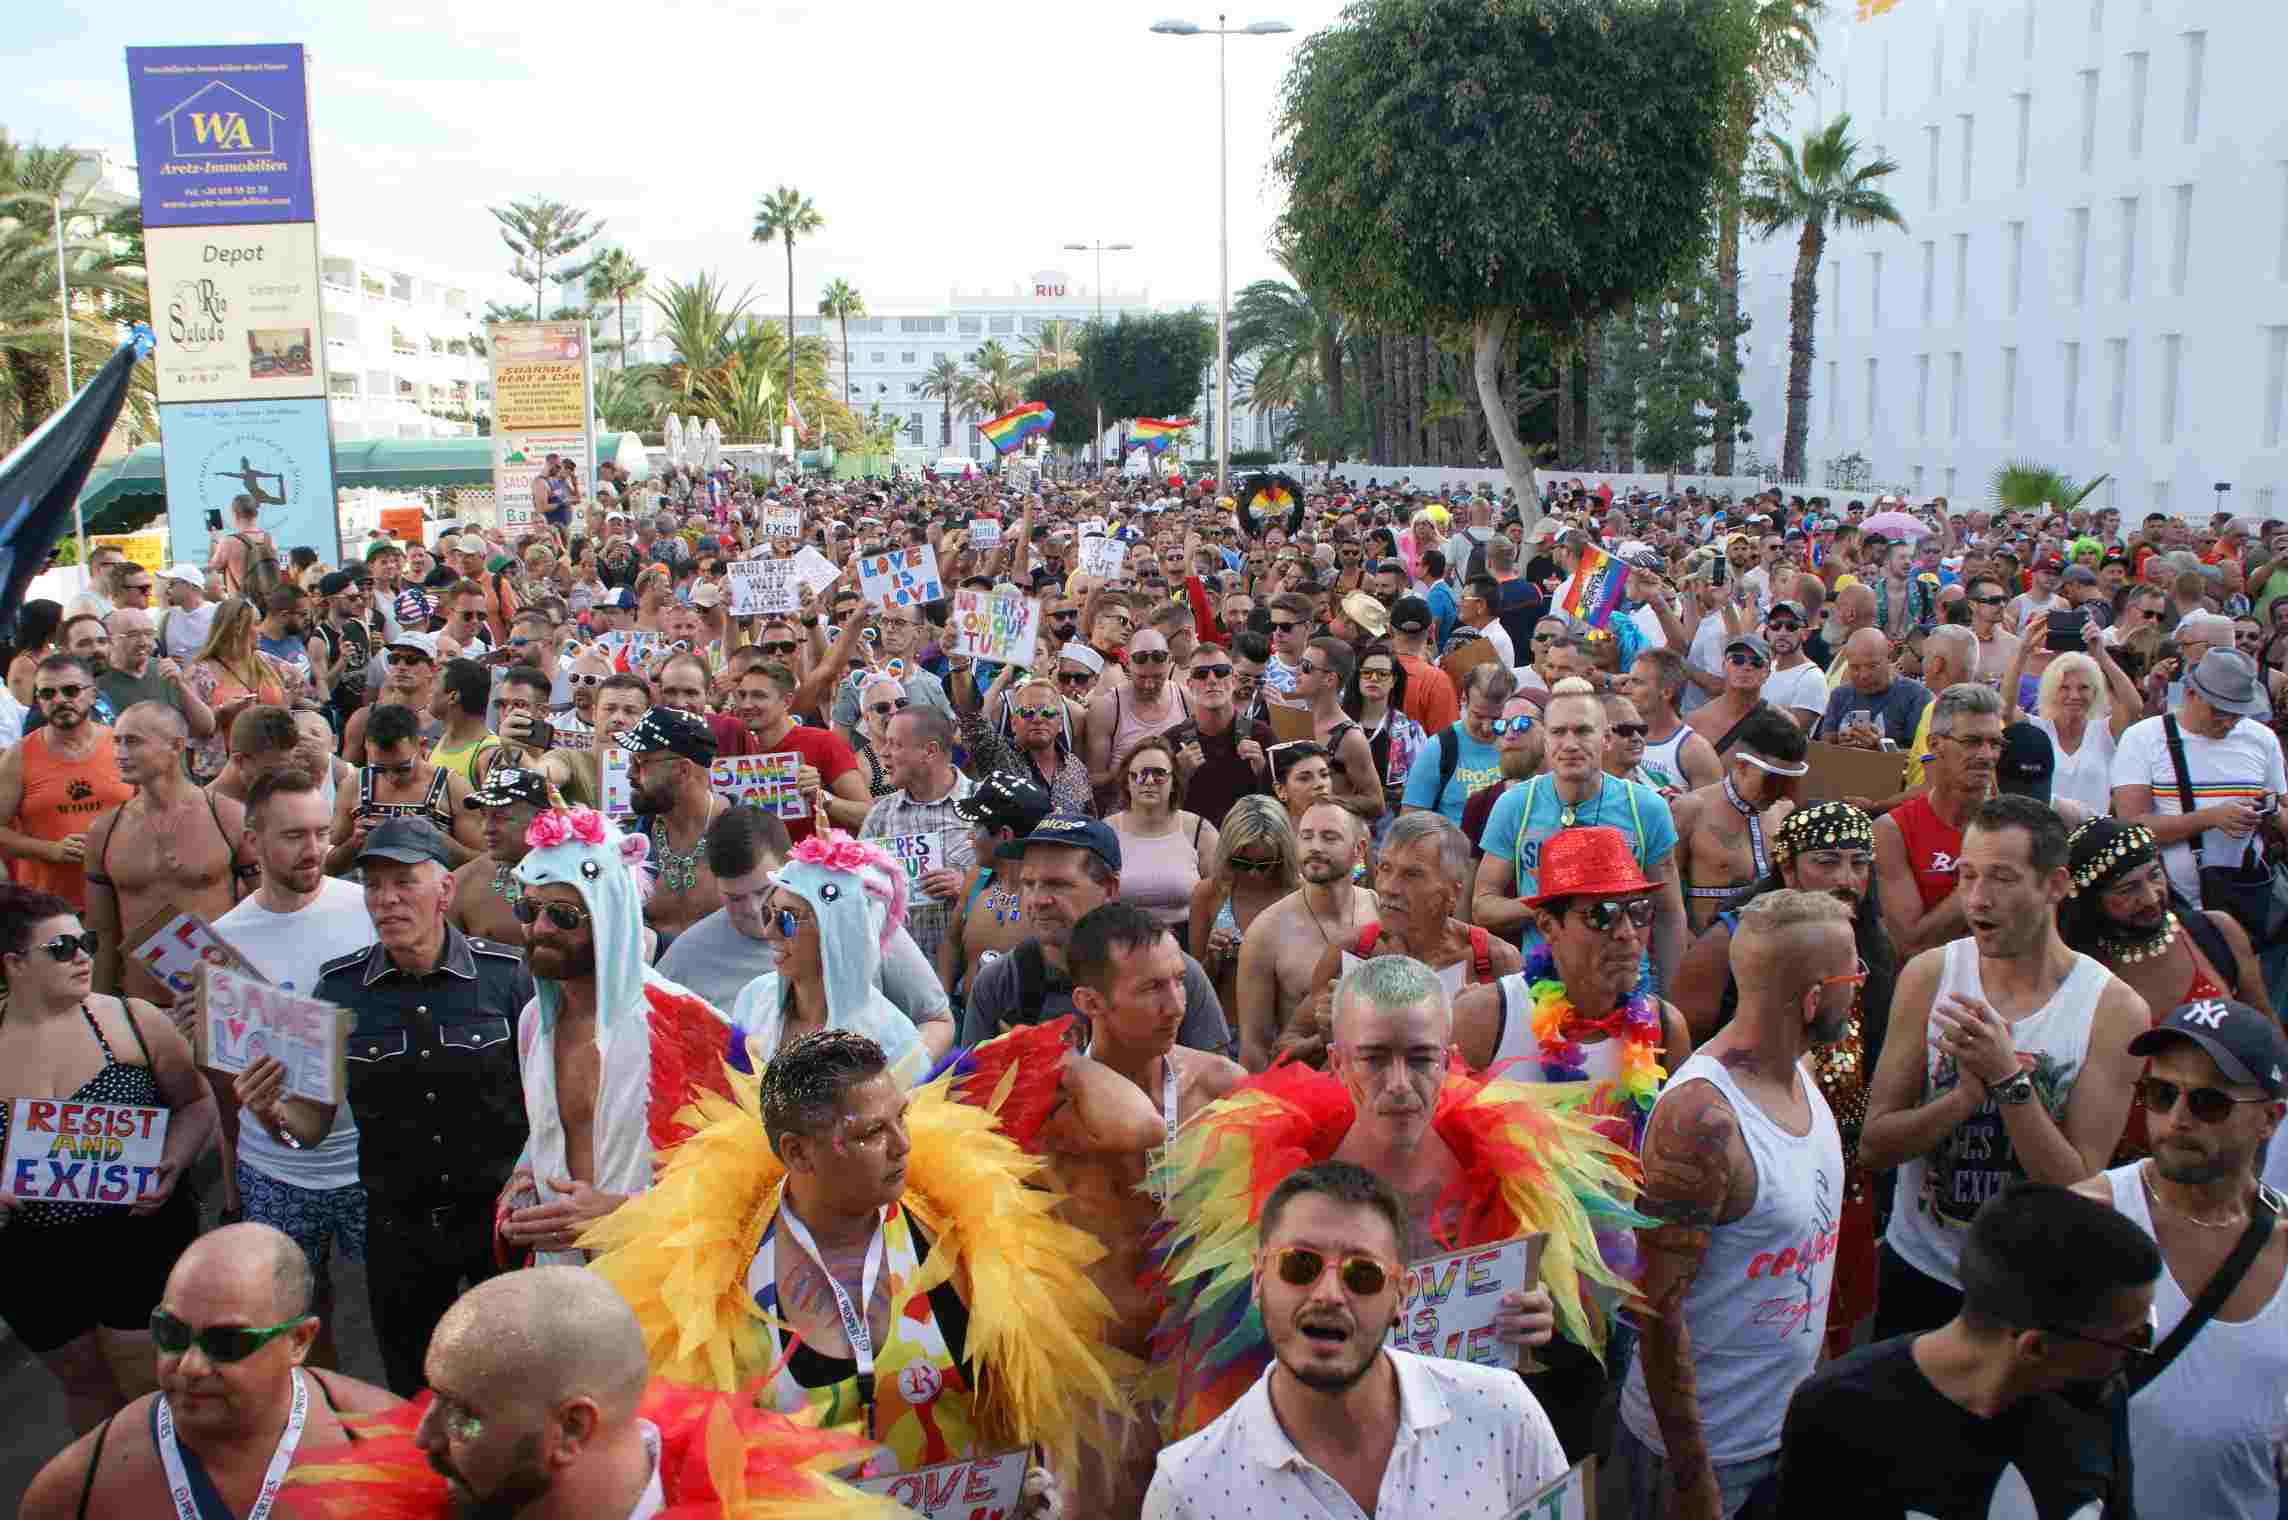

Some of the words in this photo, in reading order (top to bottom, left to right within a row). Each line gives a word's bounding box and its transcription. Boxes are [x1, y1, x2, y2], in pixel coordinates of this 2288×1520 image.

[190, 111, 253, 149] WA
[203, 244, 264, 268] Depot
[1035, 283, 1065, 297] RIU
[862, 546, 923, 577] LOVE
[892, 571, 914, 590] IS
[882, 582, 939, 609] LOVE
[711, 756, 797, 787] SAME
[26, 1101, 159, 1139] RESIST
[47, 1134, 125, 1162] AND
[886, 1455, 1002, 1513] OVE
